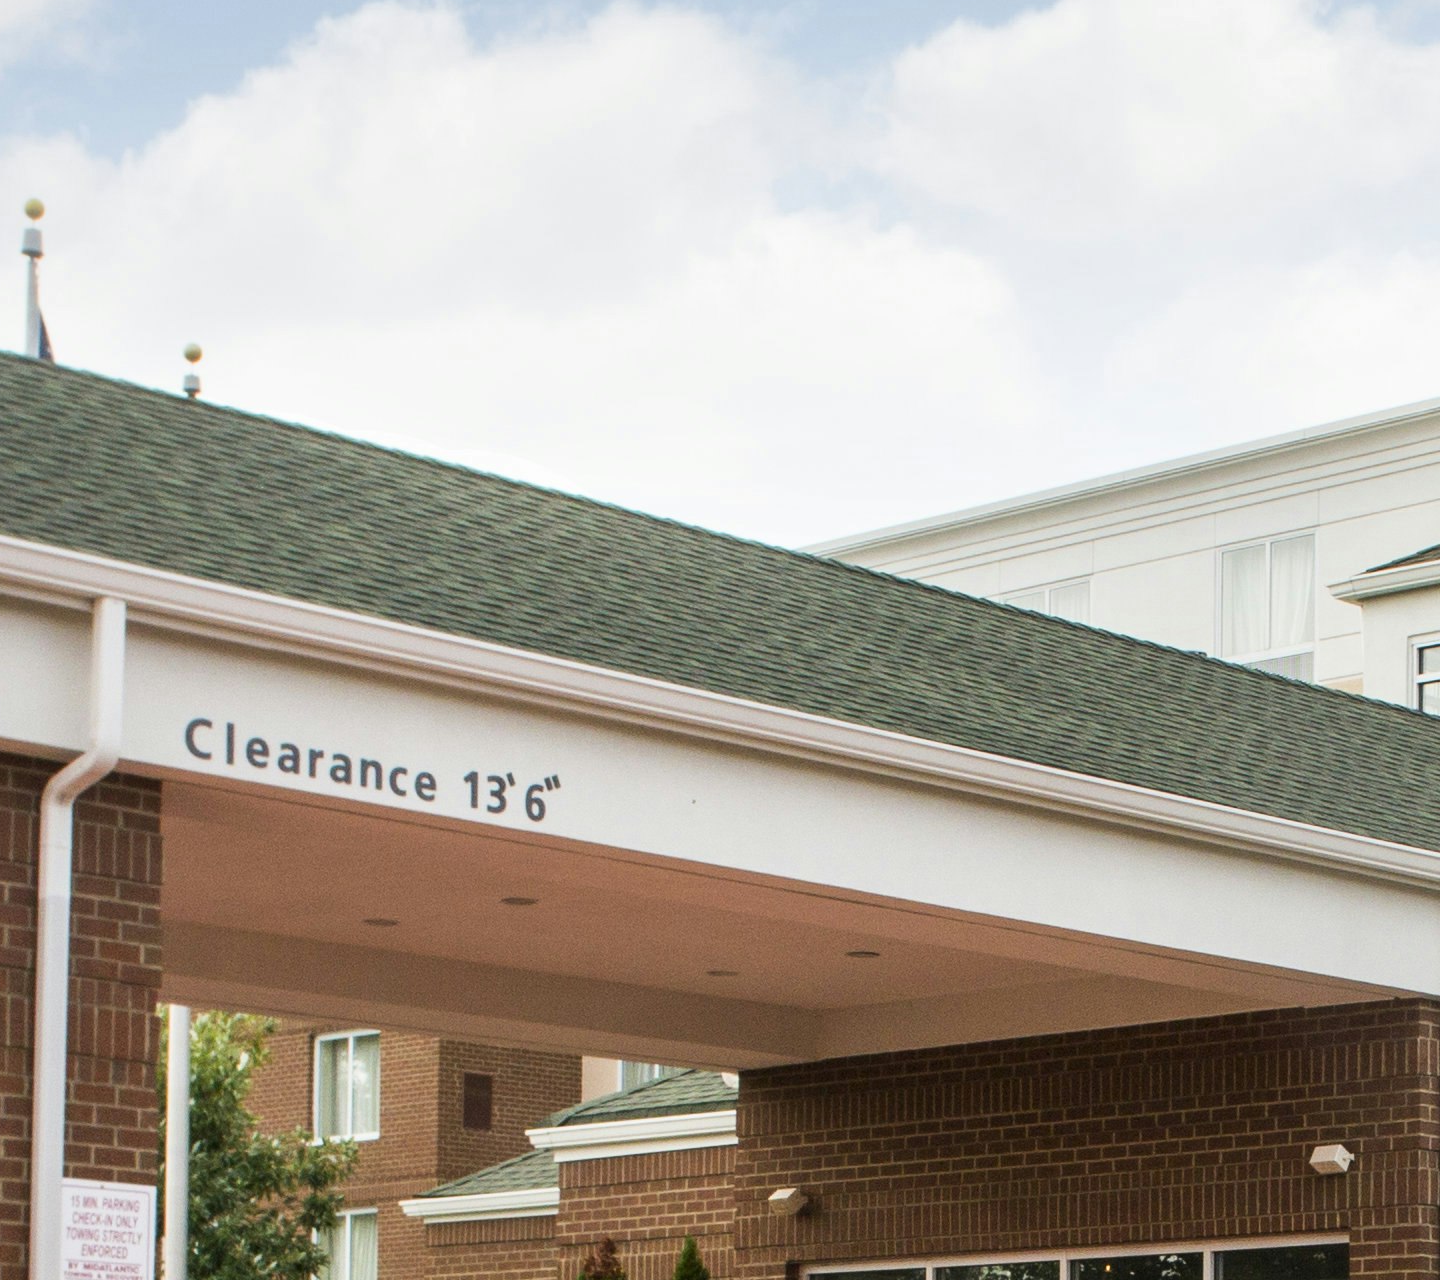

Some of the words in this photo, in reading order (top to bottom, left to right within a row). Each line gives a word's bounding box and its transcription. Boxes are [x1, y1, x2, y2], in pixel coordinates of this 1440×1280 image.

[183, 716, 438, 802] Clearance
[71, 1195, 80, 1207] 15
[102, 1197, 140, 1213] PARKING
[71, 1211, 113, 1227] CHECK-IN
[116, 1213, 139, 1229] ONLY
[66, 1227, 100, 1241] TOWING
[102, 1229, 142, 1245] STRICTLY
[81, 1244, 128, 1259] ENFORCED
[68, 1262, 78, 1270] BY
[82, 1263, 140, 1274] MIDATLANTIC
